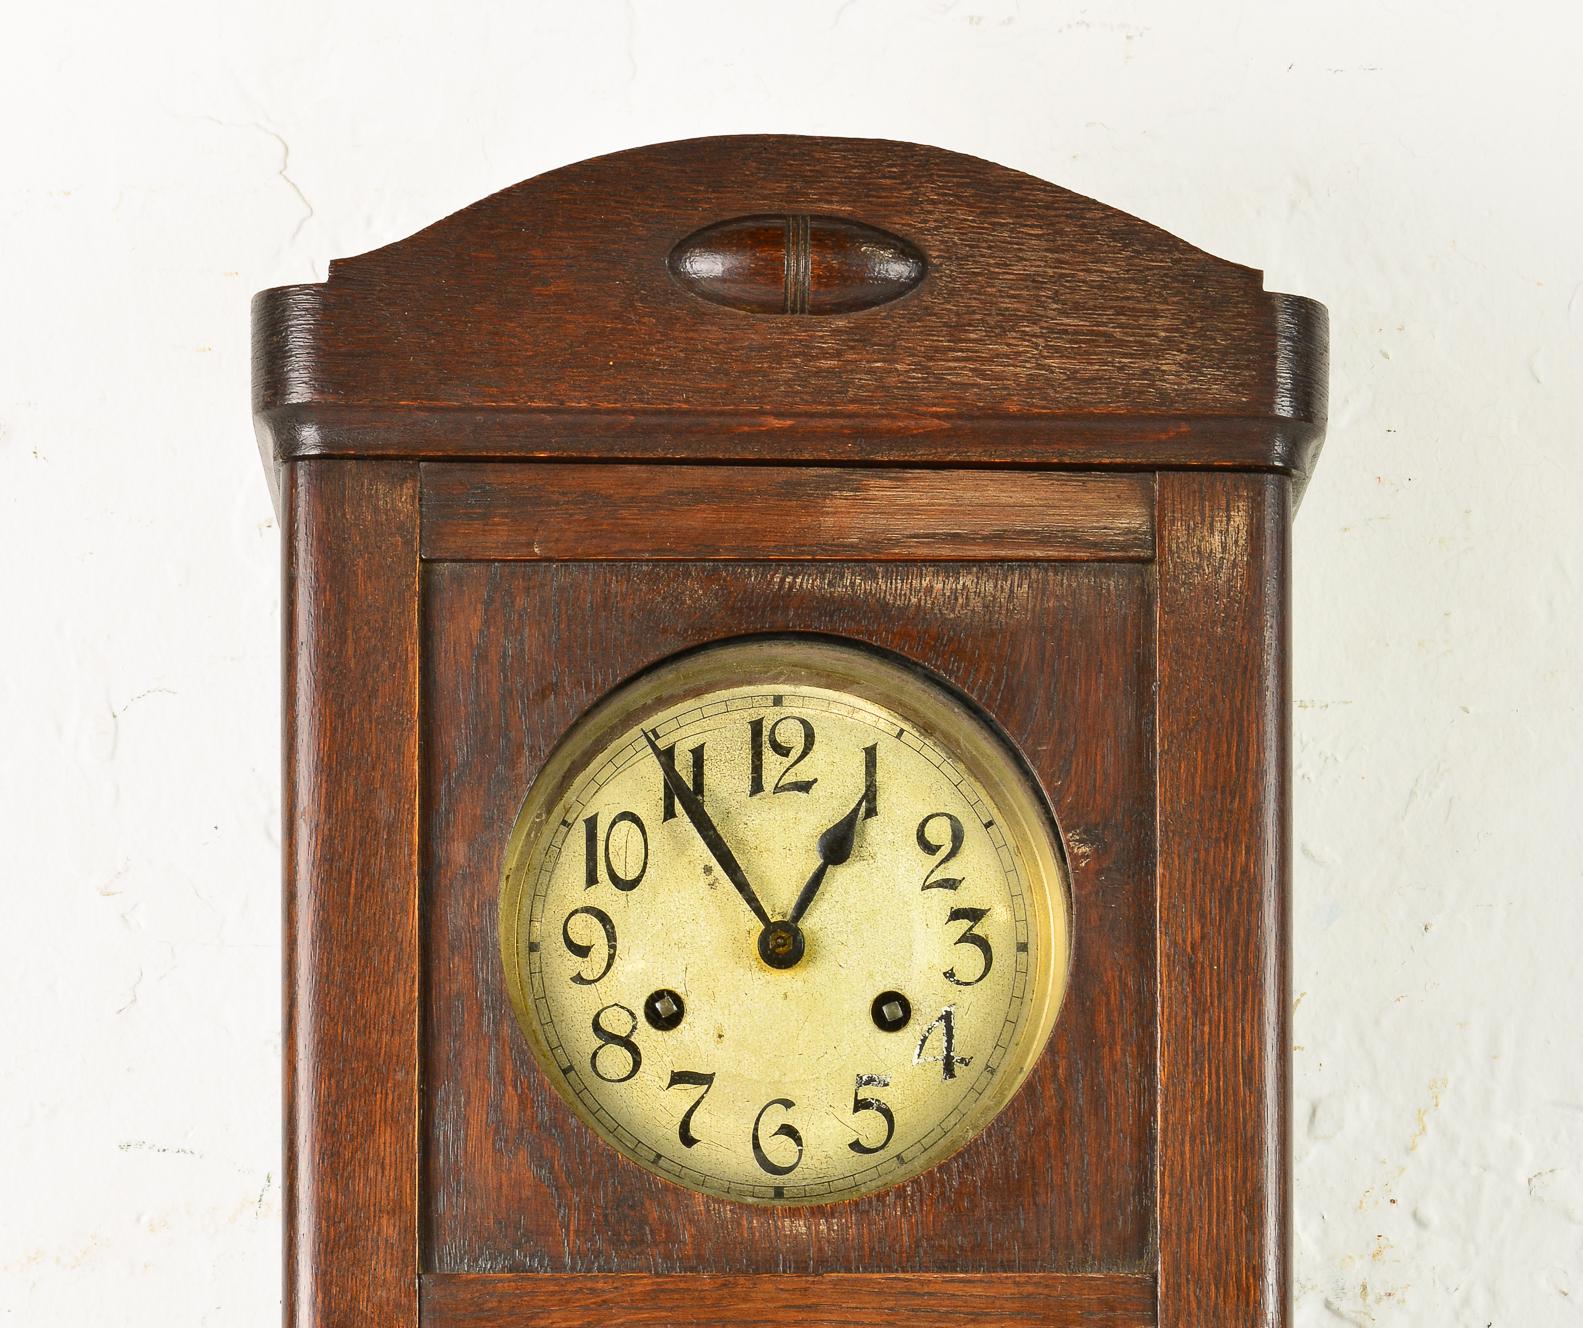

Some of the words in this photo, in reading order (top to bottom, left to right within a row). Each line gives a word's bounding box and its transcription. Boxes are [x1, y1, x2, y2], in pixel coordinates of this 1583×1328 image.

[749, 716, 818, 797] 12
[862, 742, 878, 820] 1
[583, 811, 649, 892] 10
[916, 812, 966, 892] 2
[562, 906, 618, 986] 9
[943, 907, 994, 986] 3
[591, 1003, 643, 1083] 8
[913, 1004, 974, 1081] 4
[666, 1070, 716, 1149] 7
[751, 1098, 804, 1176] 6
[848, 1073, 896, 1154] 5
